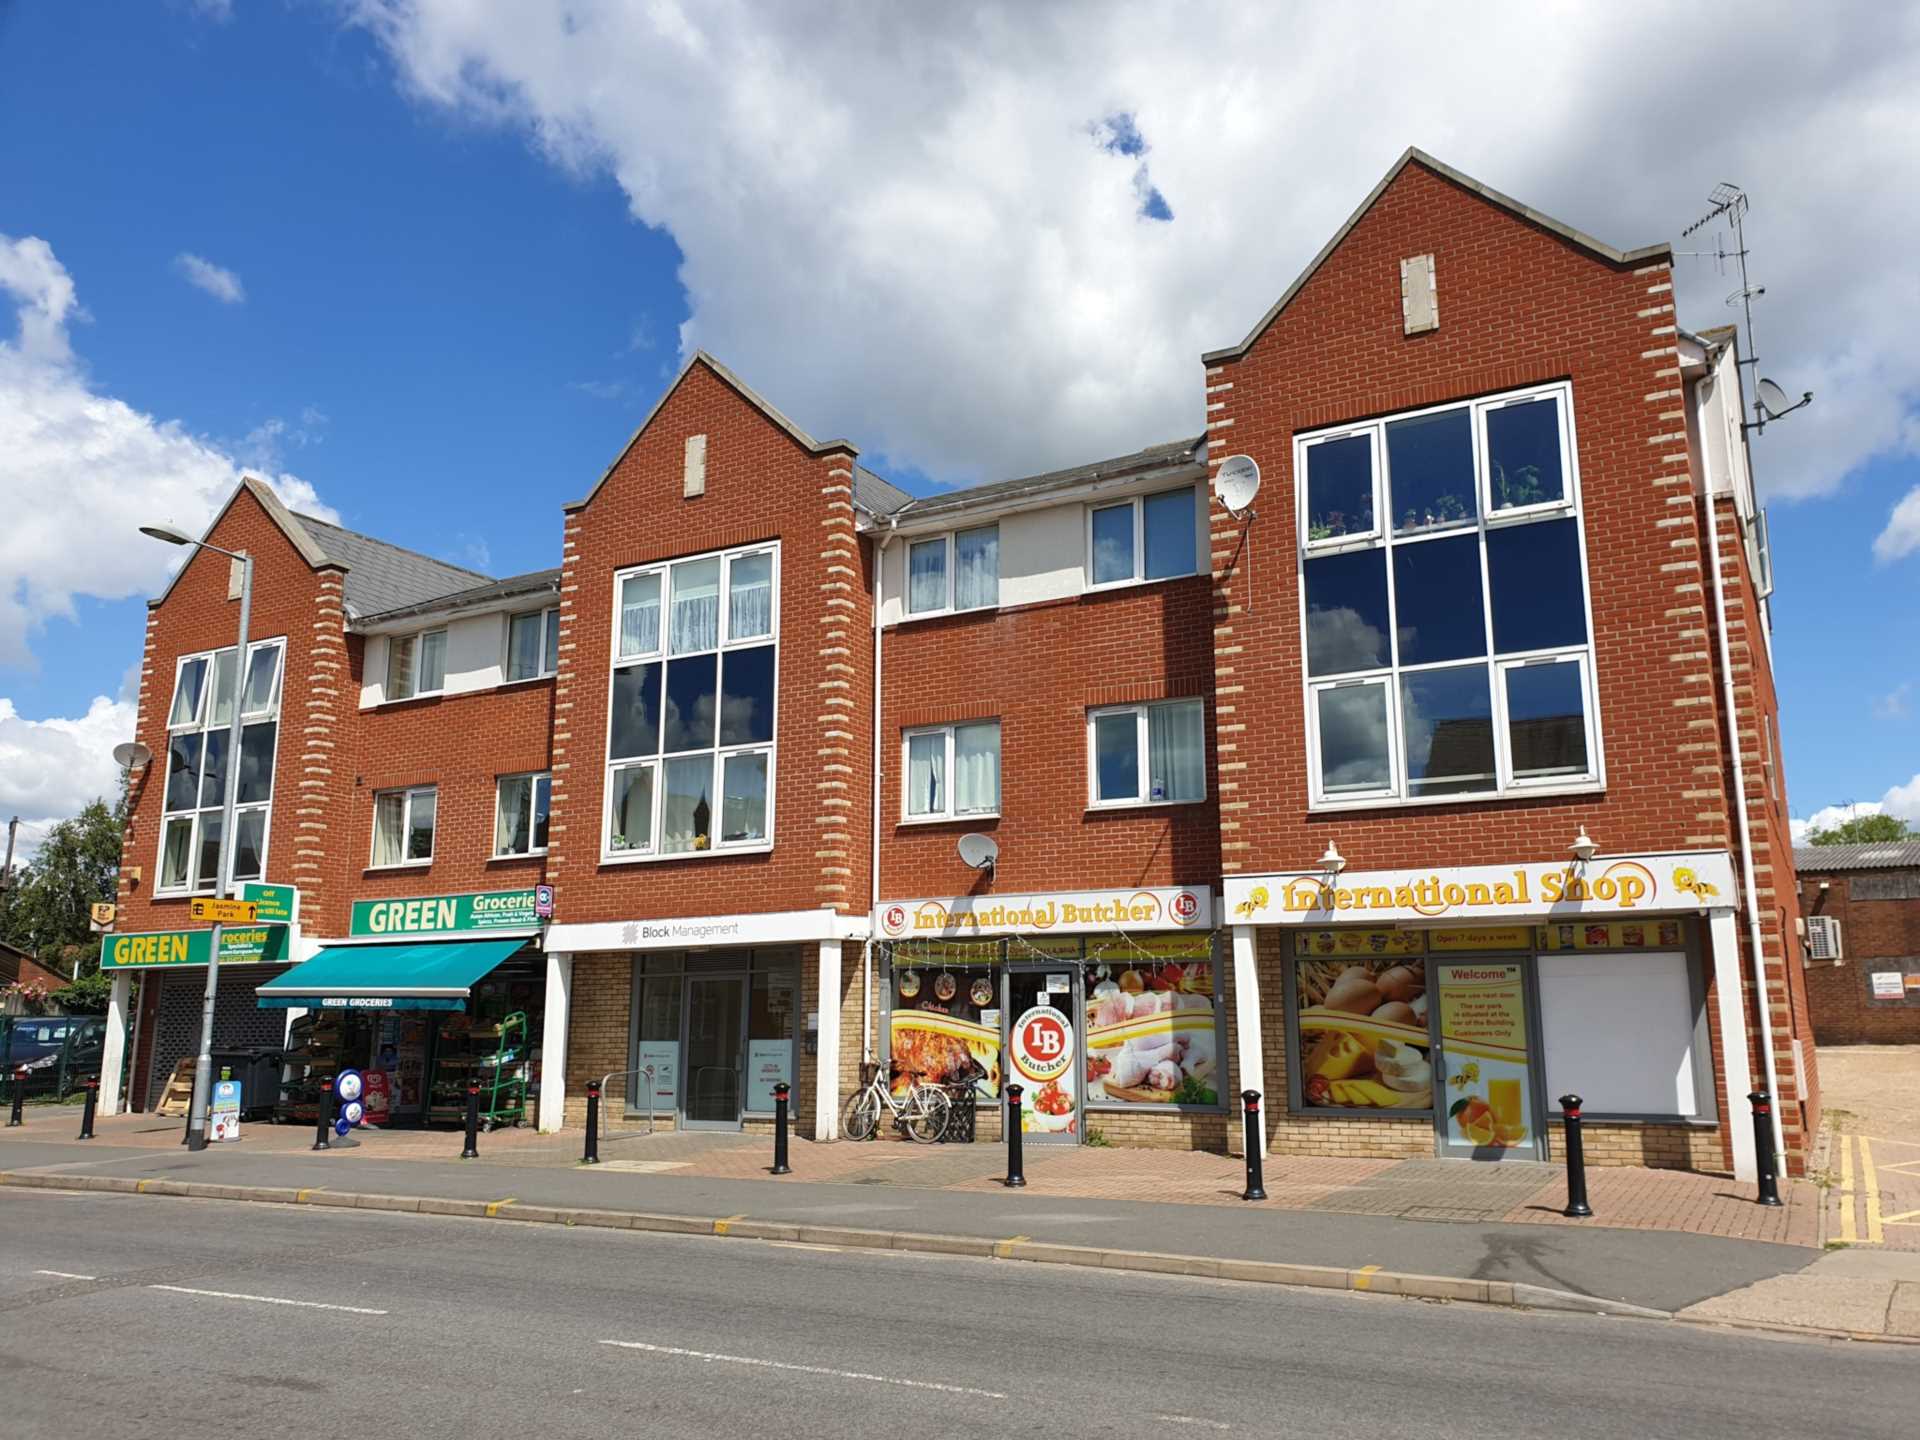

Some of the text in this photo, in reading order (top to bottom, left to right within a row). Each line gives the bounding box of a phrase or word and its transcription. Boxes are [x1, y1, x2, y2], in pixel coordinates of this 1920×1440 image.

[1281, 867, 1645, 912] International Shop
[211, 902, 241, 911] Jasmine
[216, 909, 235, 919] Park
[369, 892, 535, 933] GREEN Grocerie
[912, 898, 1156, 930] International Butcher
[1179, 896, 1195, 914] IB
[642, 922, 740, 939] Block Management
[114, 928, 268, 965] GREEN roceries
[1451, 969, 1506, 980] Welcome
[322, 998, 393, 1007] GREEN GROCERIES
[1018, 1007, 1069, 1029] International
[1498, 1010, 1510, 1018] the
[1031, 1022, 1061, 1055] IB
[1020, 1053, 1067, 1073] Butcher
